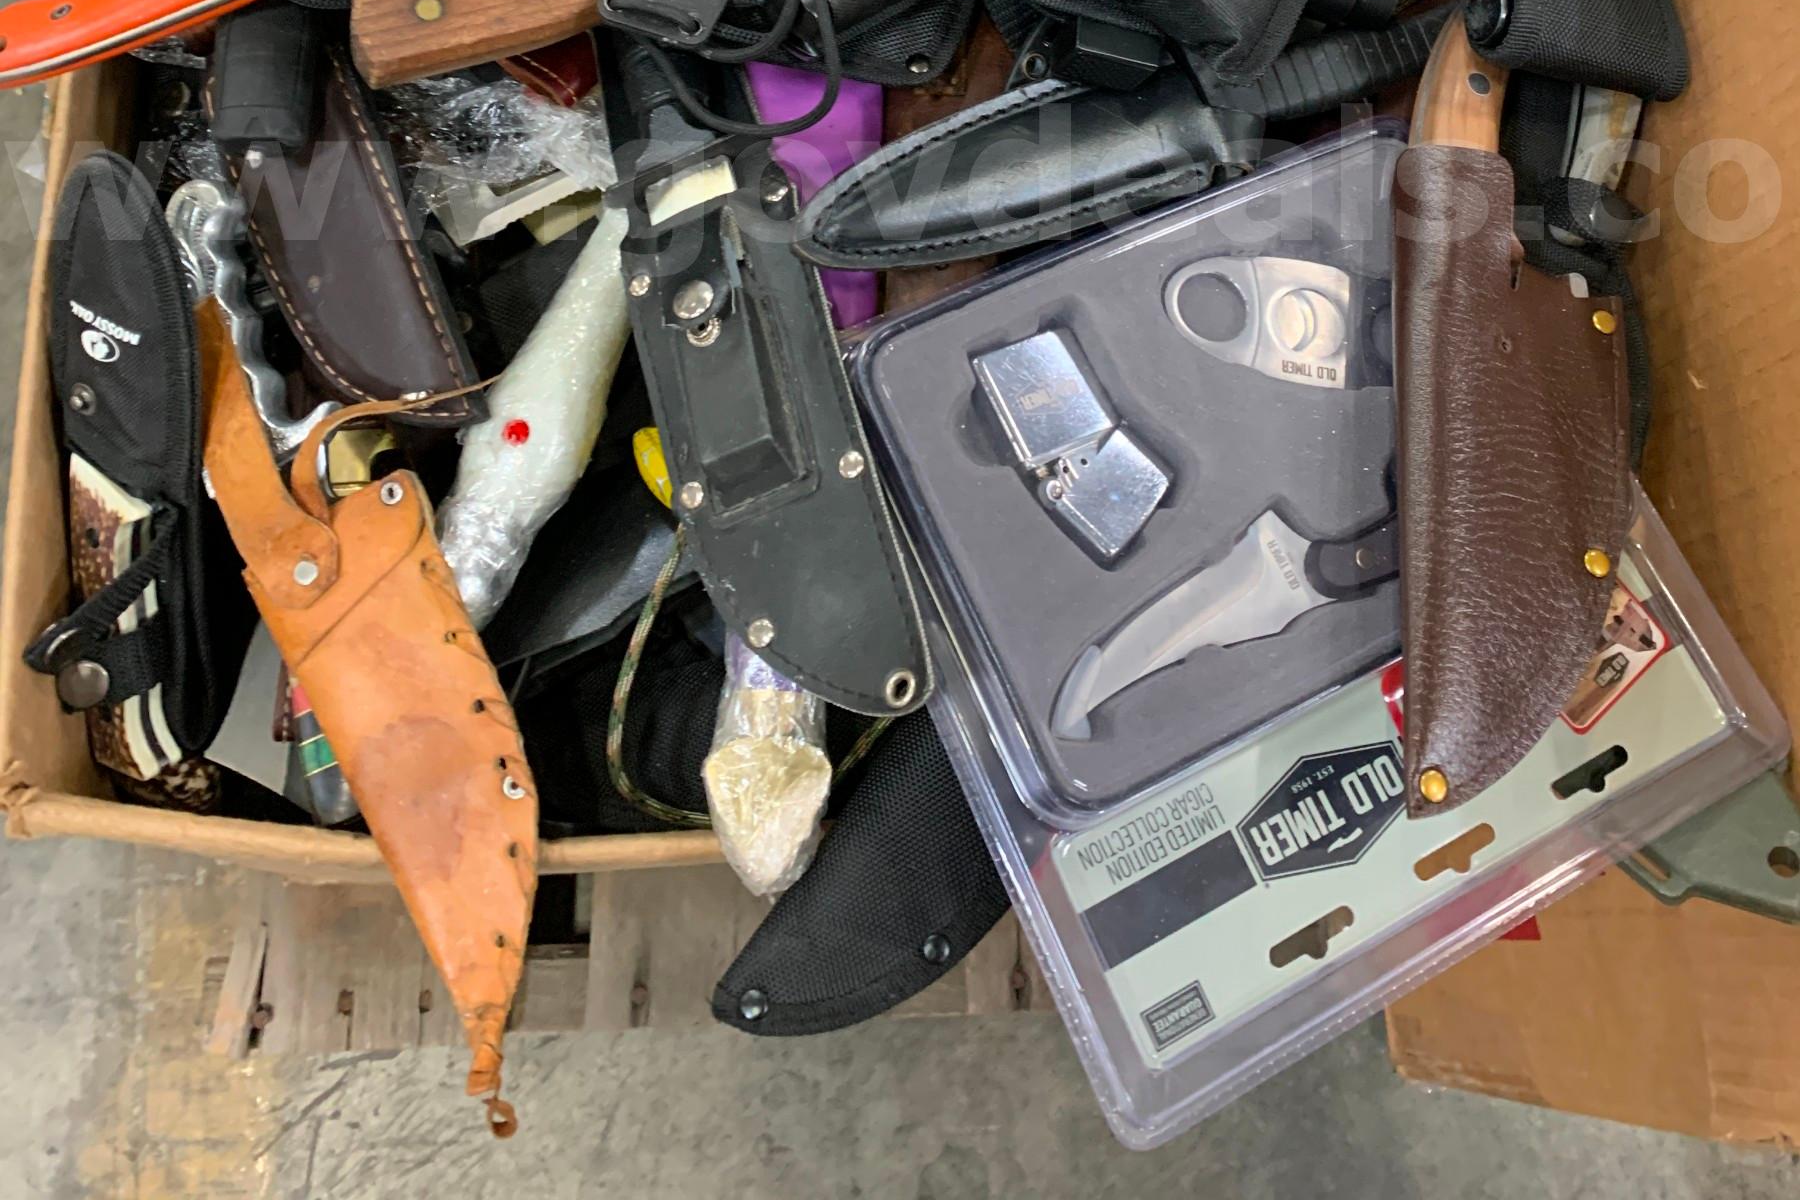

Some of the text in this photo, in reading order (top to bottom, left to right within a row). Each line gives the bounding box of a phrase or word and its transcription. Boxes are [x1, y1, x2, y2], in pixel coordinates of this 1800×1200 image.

[92, 316, 141, 346] MOSSY
[1281, 359, 1337, 381] OLD TIMER
[1312, 764, 1335, 781] EST.
[1076, 782, 1214, 871] CIGAR COLLECTION
[1249, 754, 1405, 866] OLD TIMER
[1105, 804, 1226, 886] LIMITED EDITION
[1151, 997, 1202, 1033] GUARANTEE
